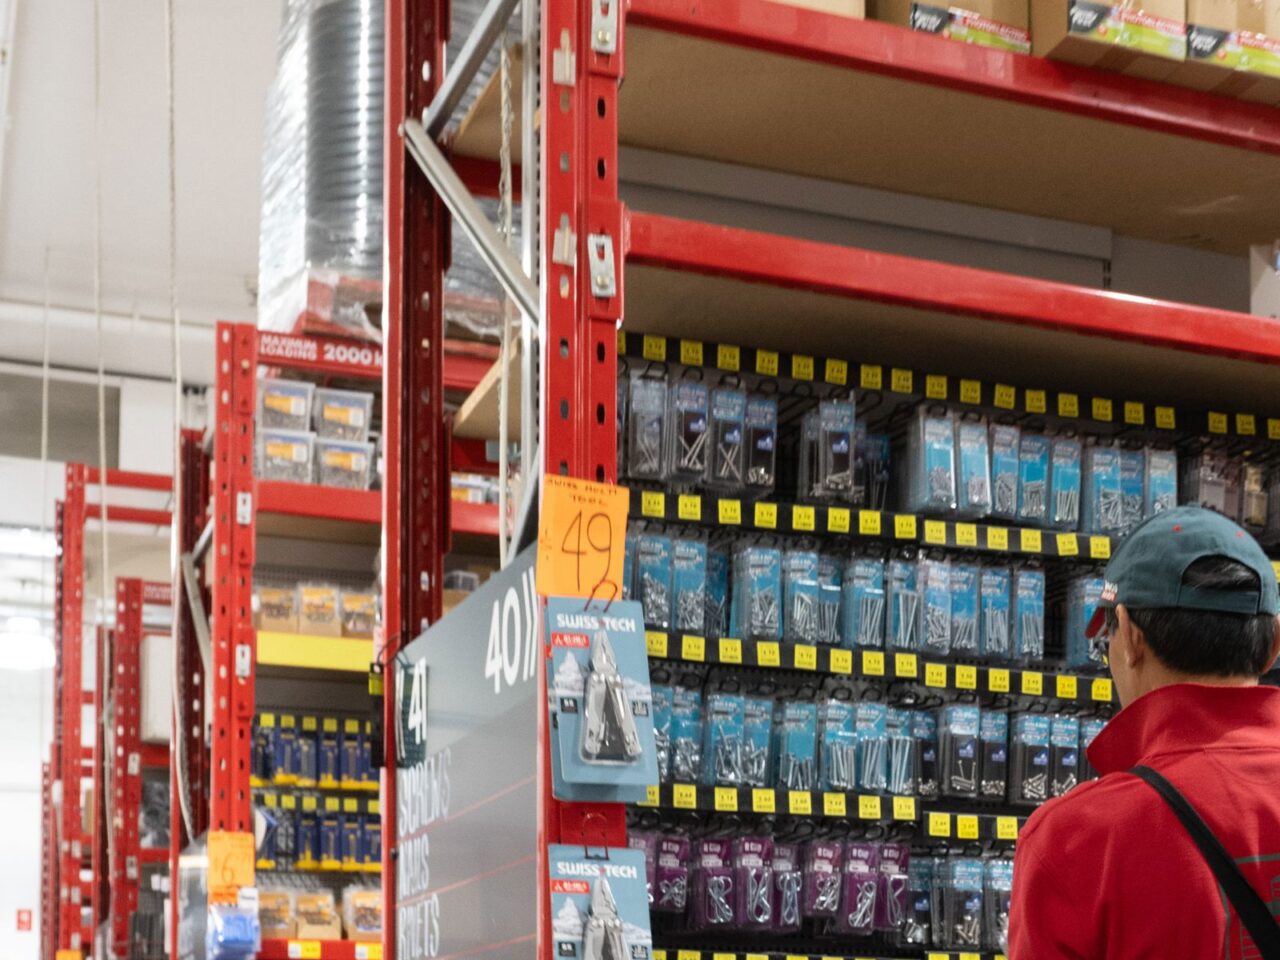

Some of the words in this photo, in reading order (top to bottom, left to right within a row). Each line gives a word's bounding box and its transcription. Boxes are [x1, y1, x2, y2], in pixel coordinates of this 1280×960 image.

[323, 343, 372, 367] 2000
[557, 613, 598, 631] SWISS
[604, 616, 636, 632] TECH
[485, 587, 521, 695] 40
[407, 656, 427, 746] 41
[557, 861, 600, 877] SWISS
[604, 864, 638, 880] TECH
